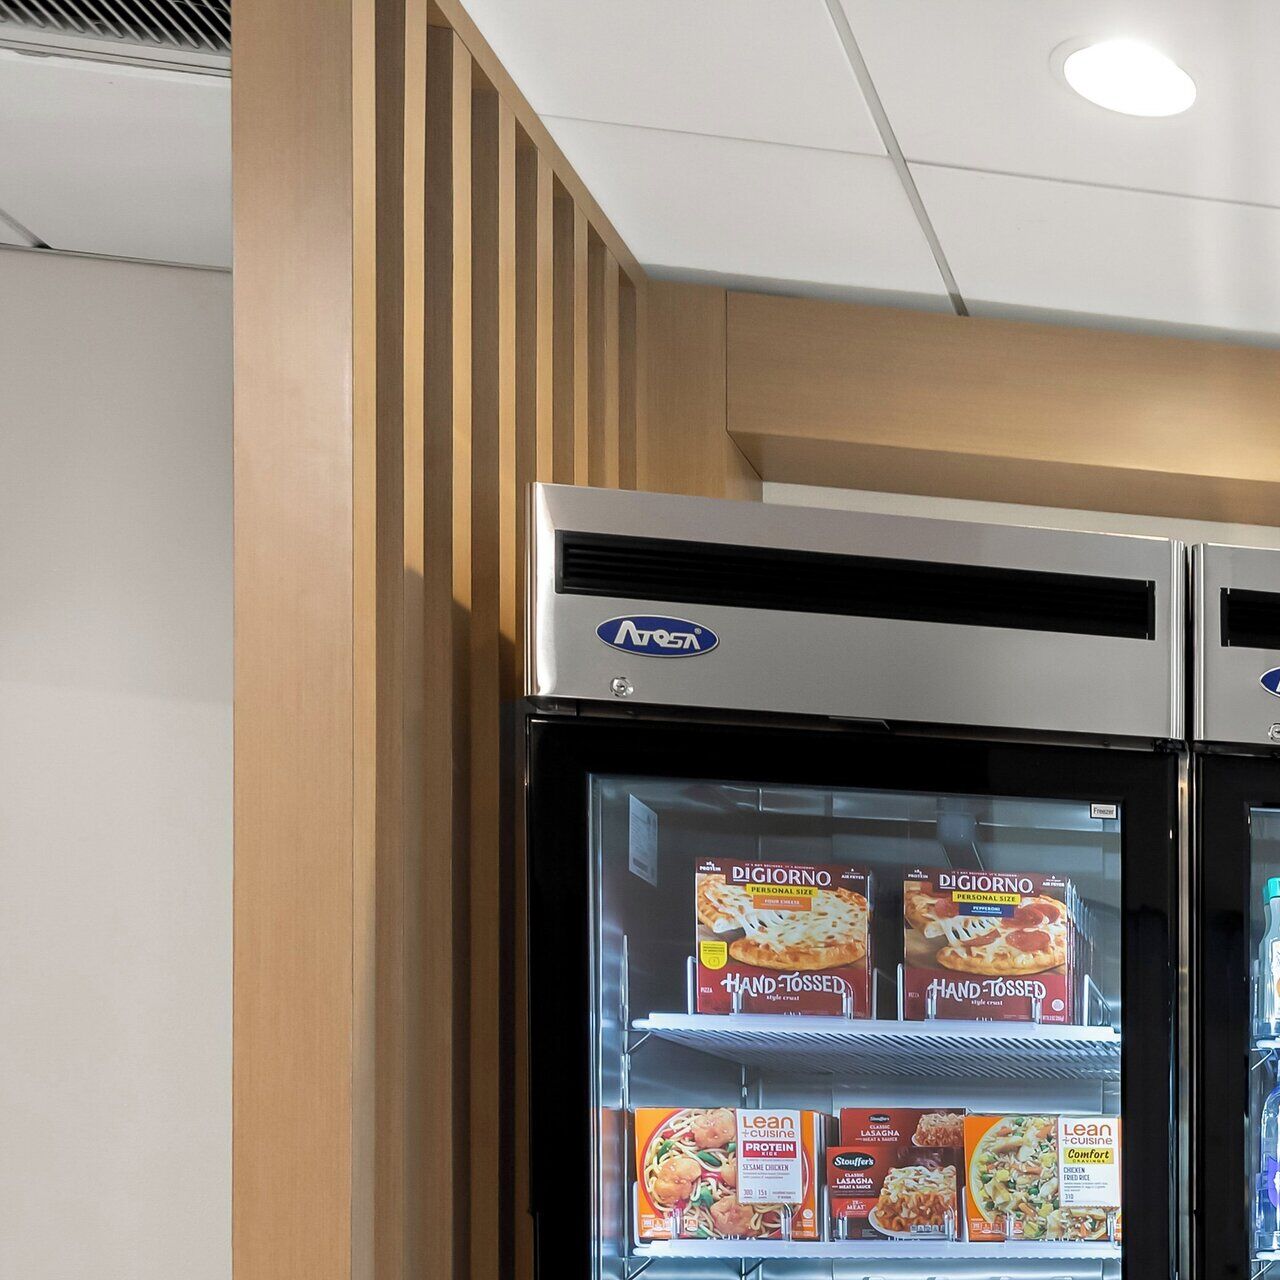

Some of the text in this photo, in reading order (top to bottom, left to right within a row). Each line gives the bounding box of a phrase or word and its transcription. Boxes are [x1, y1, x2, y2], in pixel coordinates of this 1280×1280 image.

[613, 620, 701, 650] ATOSA
[1093, 807, 1115, 815] Freezer
[750, 886, 794, 895] PERSONAL
[957, 893, 998, 902] PERSONAL
[720, 971, 847, 997] HAND-TOSSED
[926, 976, 1048, 1002] HAND-TOSSED
[743, 1115, 794, 1129] Lean
[860, 1129, 900, 1137] LASAGNA
[1064, 1123, 1112, 1136] Lean
[745, 1142, 795, 1152] PROTEIN
[1067, 1148, 1110, 1160] Comfort
[834, 1156, 875, 1167] Stouffer's
[742, 1163, 790, 1172] SESAME CHICKEN
